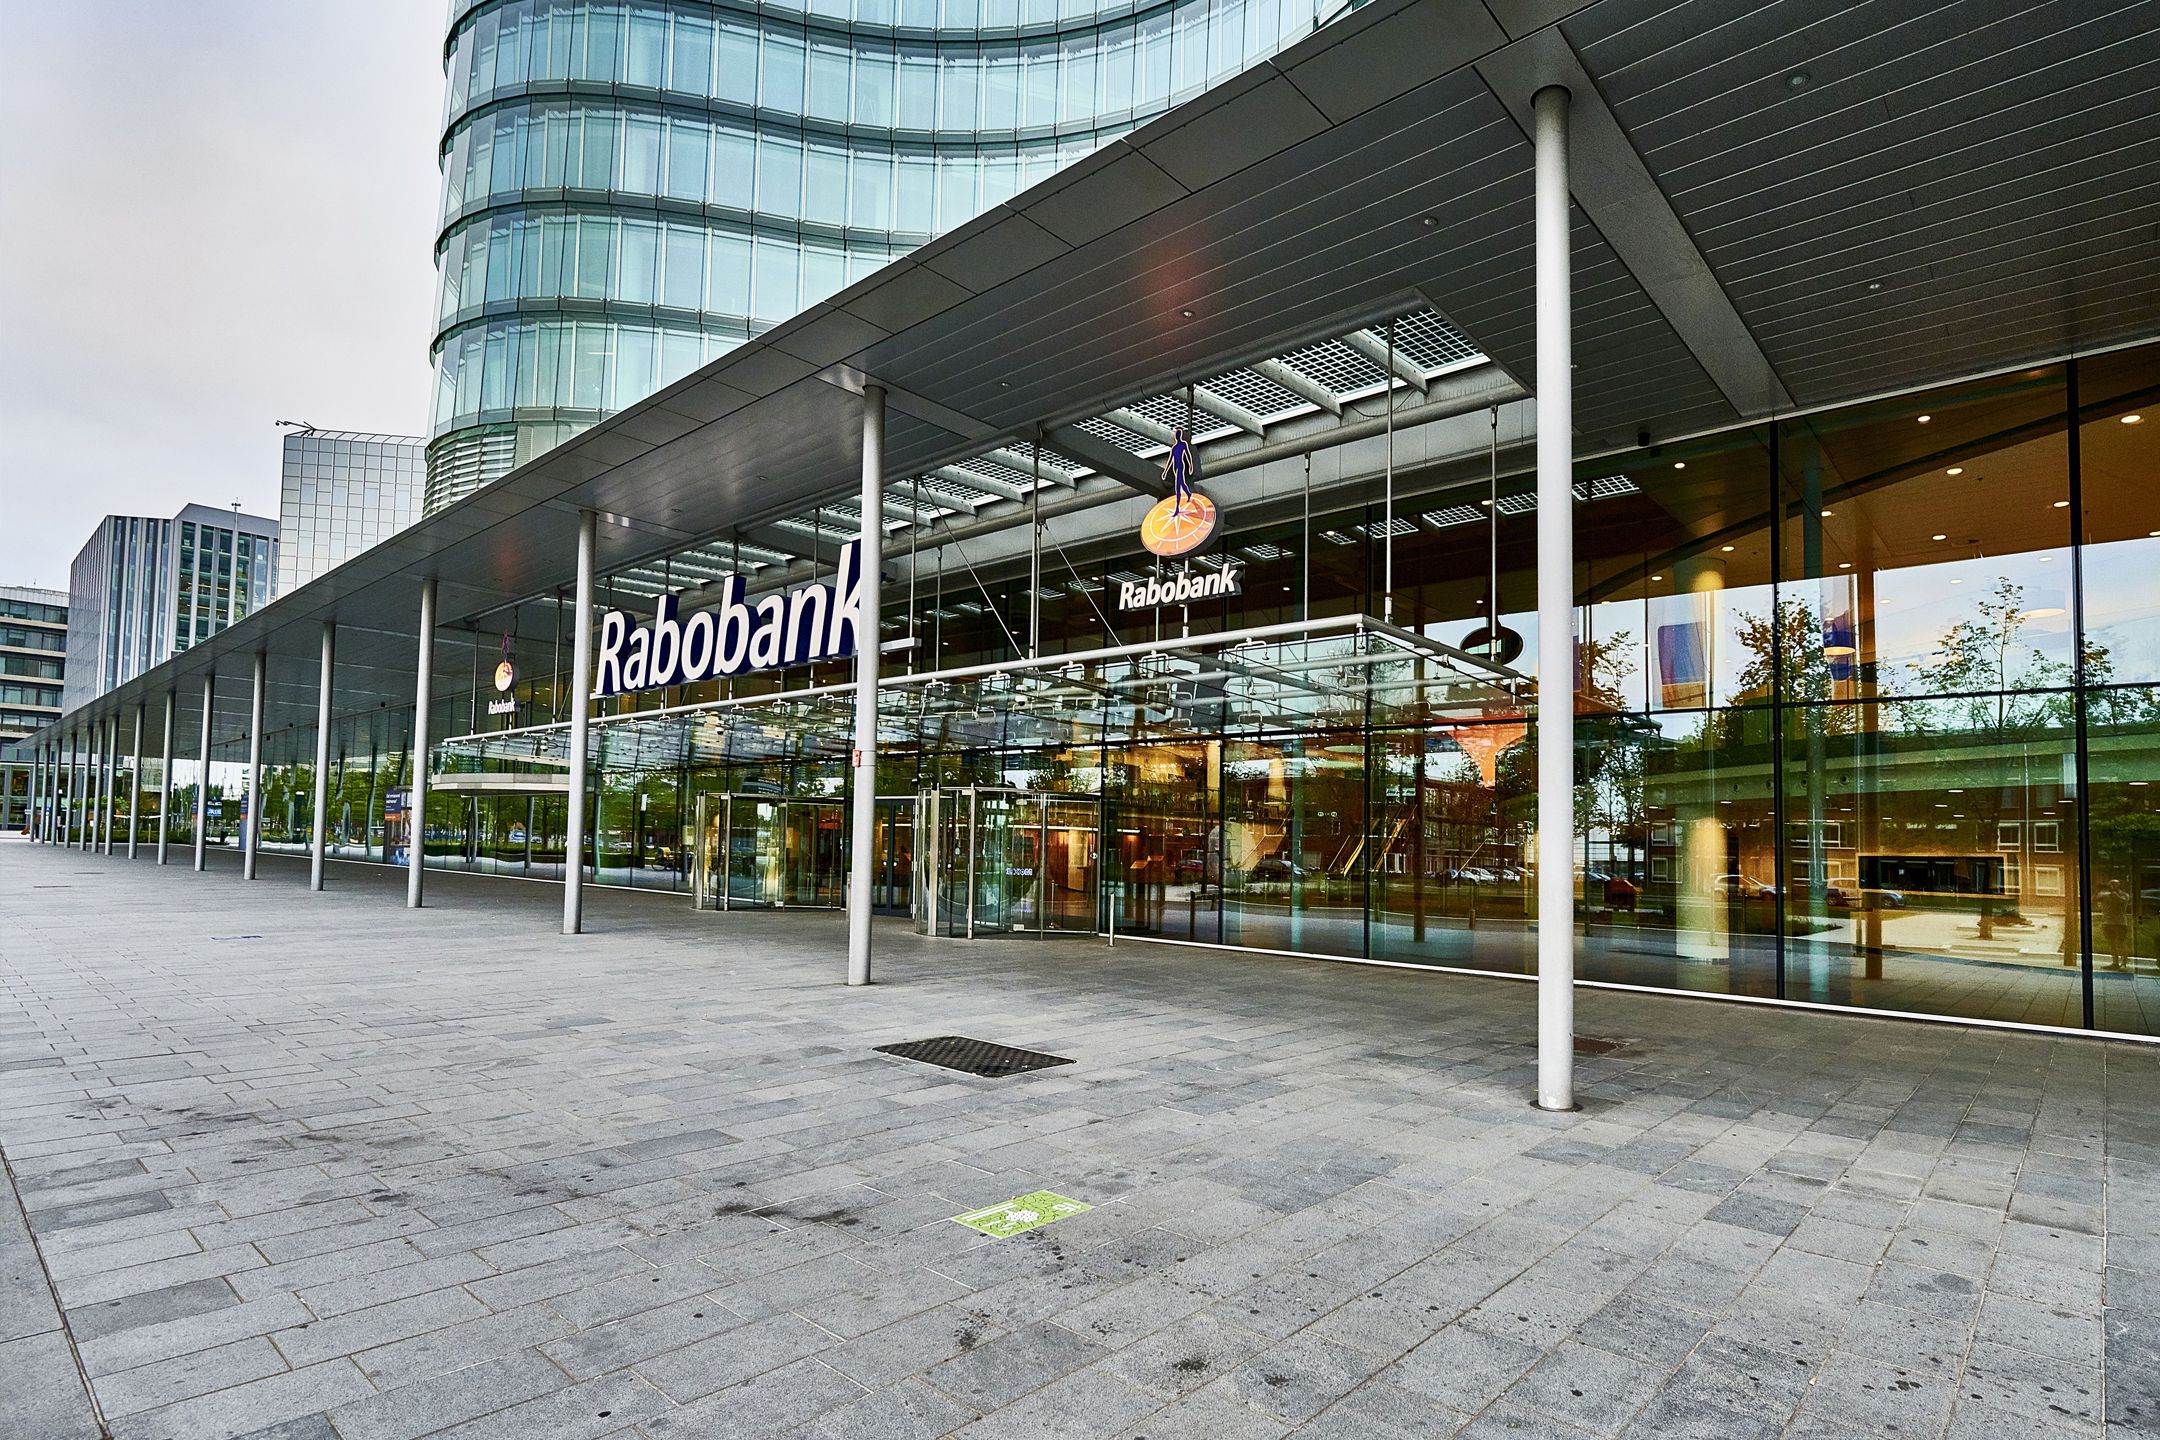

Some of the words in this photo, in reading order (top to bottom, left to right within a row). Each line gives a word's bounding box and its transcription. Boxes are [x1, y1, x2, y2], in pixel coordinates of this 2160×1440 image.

[1119, 562, 1238, 610] Rabobank
[596, 540, 862, 695] Rabobank
[488, 692, 515, 715] Rabobank
